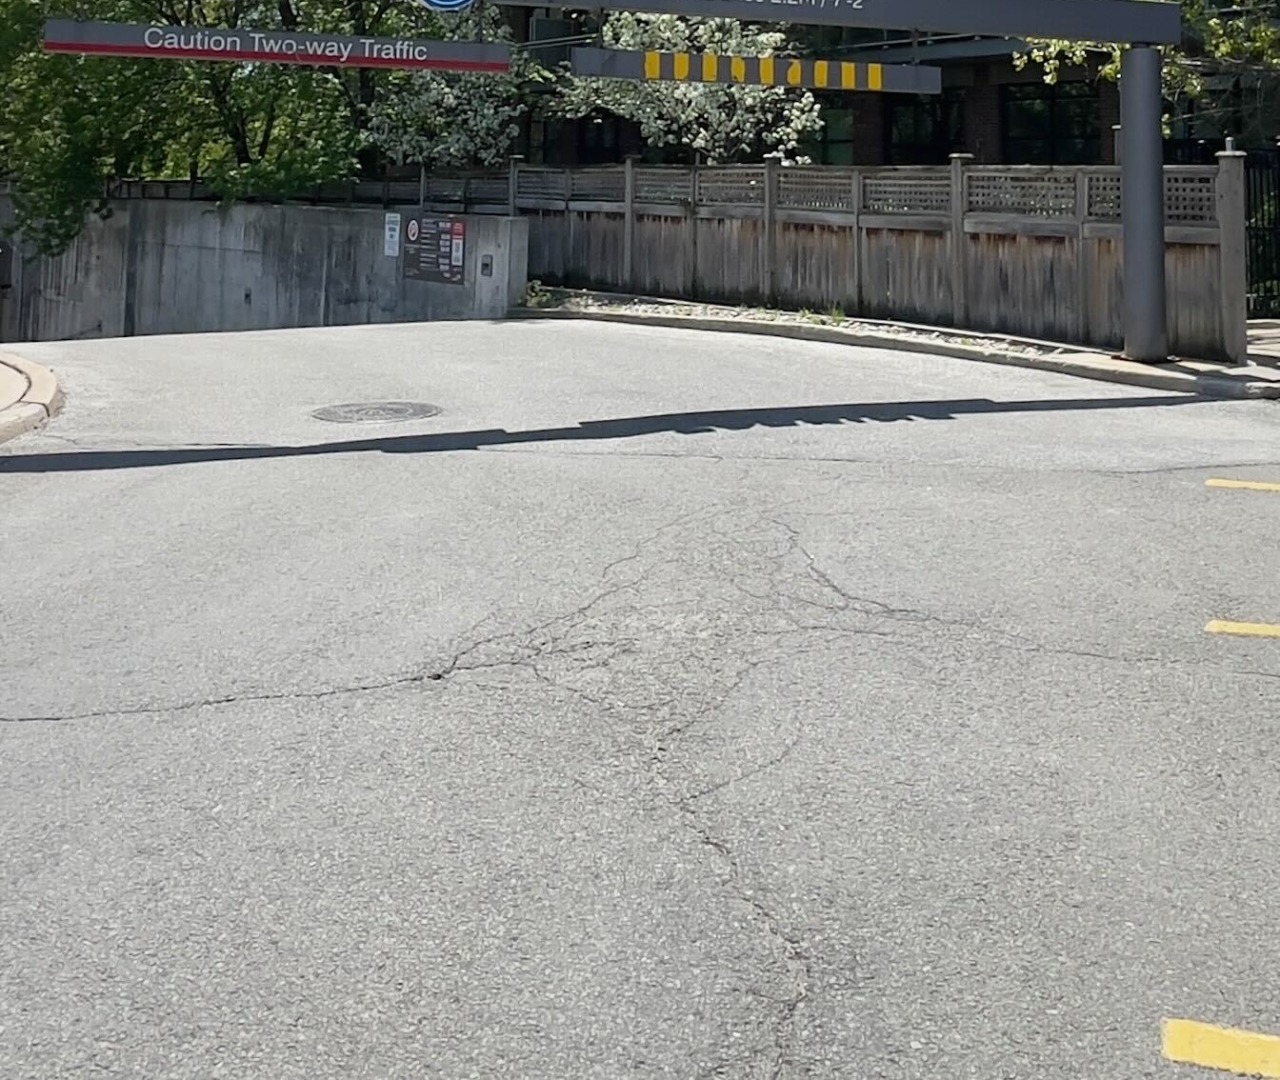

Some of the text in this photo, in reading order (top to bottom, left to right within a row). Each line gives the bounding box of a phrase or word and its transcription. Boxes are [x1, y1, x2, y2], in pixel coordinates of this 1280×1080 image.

[144, 27, 428, 62] Caution Two-way Traffic
